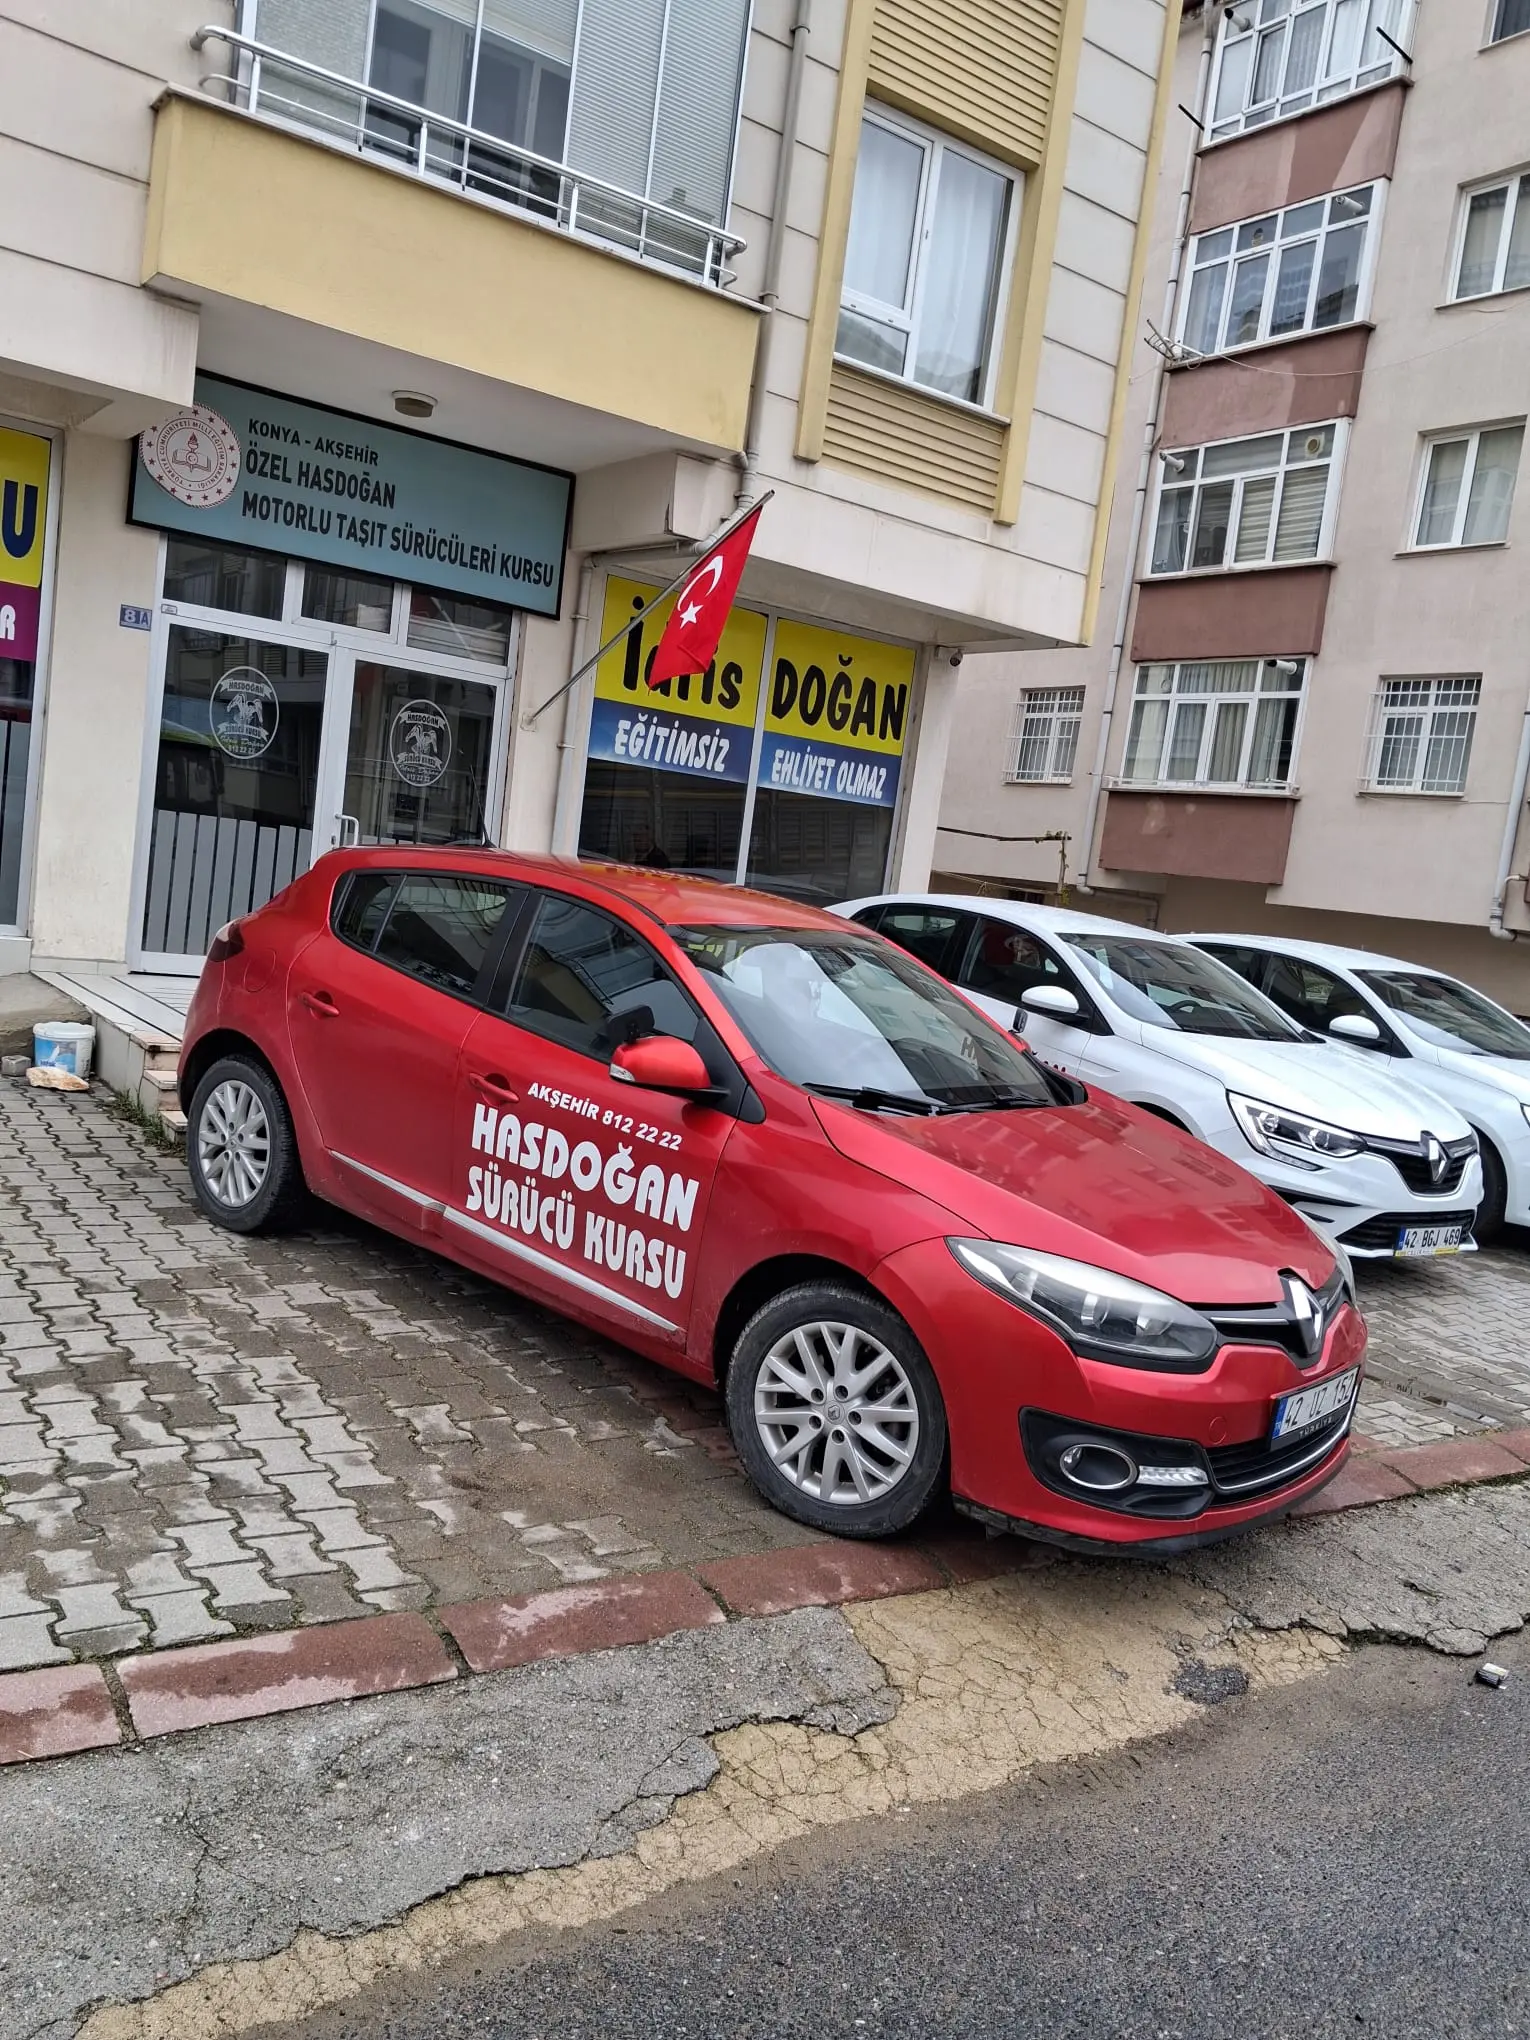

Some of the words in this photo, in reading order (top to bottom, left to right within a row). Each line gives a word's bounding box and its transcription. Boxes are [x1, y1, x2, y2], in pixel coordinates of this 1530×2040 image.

[246, 440, 292, 484] ÖZEL
[297, 460, 396, 509] HASDOĞAN
[249, 418, 300, 446] KONYA
[314, 437, 379, 467] AKŞEHİR
[2, 480, 38, 558] U
[242, 490, 332, 535] MOTORLU
[336, 512, 387, 548] TAŞIT
[389, 522, 497, 574] SÜRÜCÜLERİ
[500, 552, 554, 588] KURSU
[771, 653, 908, 742] DOĞAN
[614, 712, 731, 773] EĞİTİMSİZ
[771, 746, 836, 791] EHLİYET
[836, 760, 887, 799] OLMAZ
[527, 1082, 600, 1120] AKŞEHİR
[602, 1109, 634, 1134] 812
[635, 1123, 659, 1144] 22
[659, 1131, 683, 1151] 22
[471, 1102, 700, 1232] HASDOĞAN
[466, 1161, 576, 1250] SÜRÜCÜ
[583, 1211, 687, 1300] KURSU
[1404, 1230, 1418, 1249] 42
[1421, 1229, 1440, 1248] BGJ
[1443, 1228, 1461, 1246] 469
[1285, 1397, 1304, 1428] 42
[1309, 1386, 1328, 1419] UZ
[1333, 1372, 1355, 1408] 152
